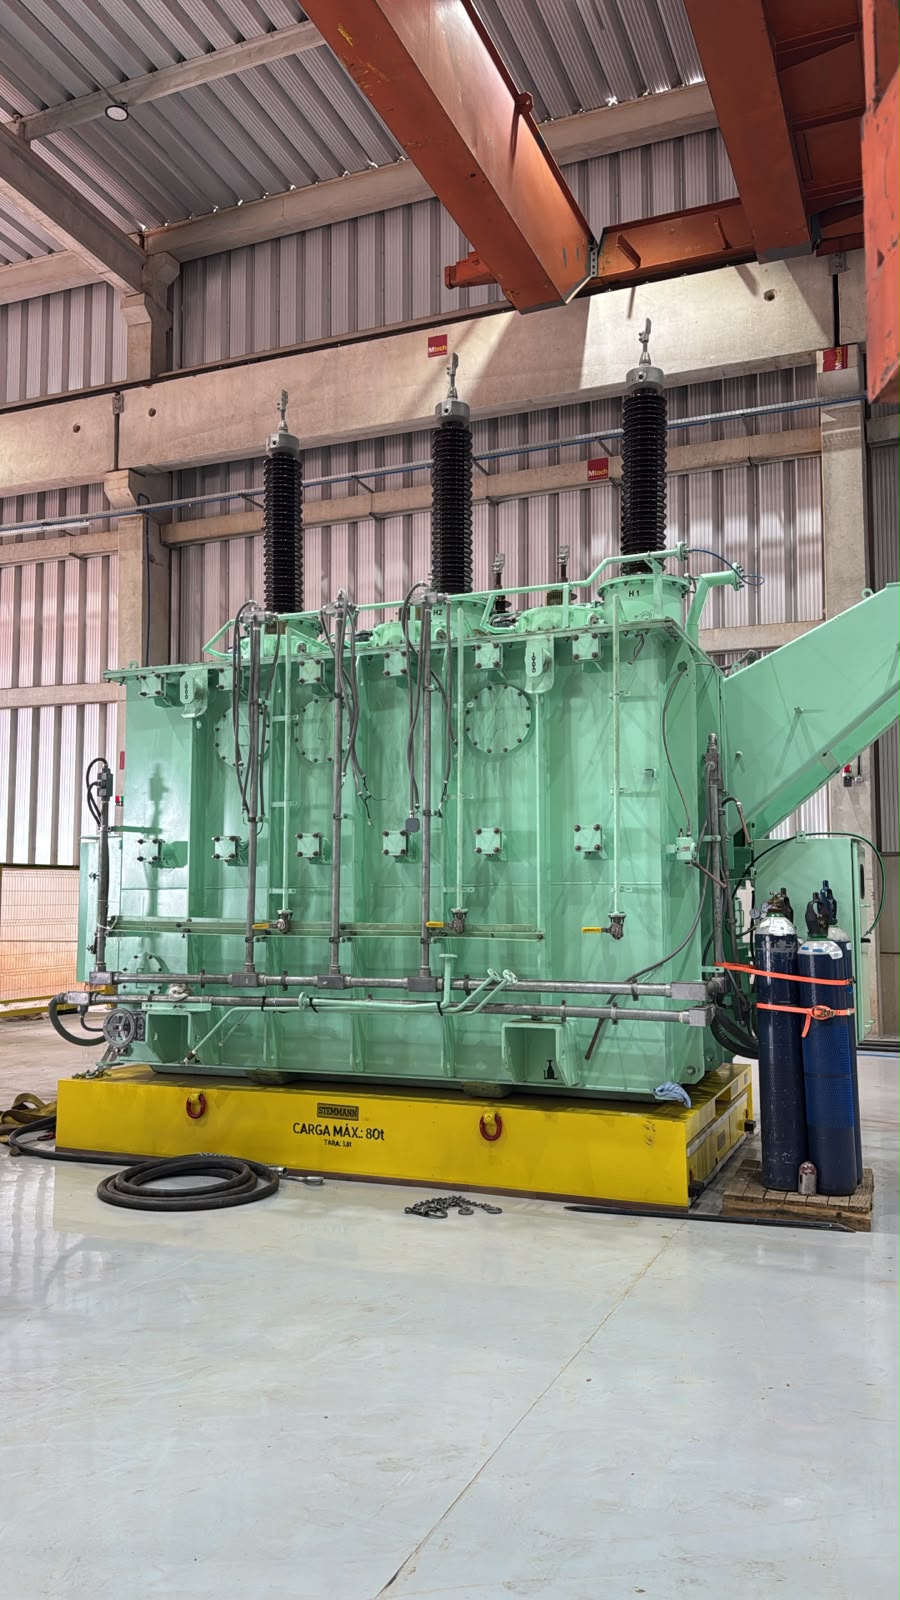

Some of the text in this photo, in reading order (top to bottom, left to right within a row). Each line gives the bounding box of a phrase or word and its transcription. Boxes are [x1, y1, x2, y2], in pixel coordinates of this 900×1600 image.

[428, 345, 448, 353] Mtech
[318, 1106, 357, 1118] STEMMANN
[292, 1122, 331, 1137] CARGA
[365, 1127, 385, 1141] 80t
